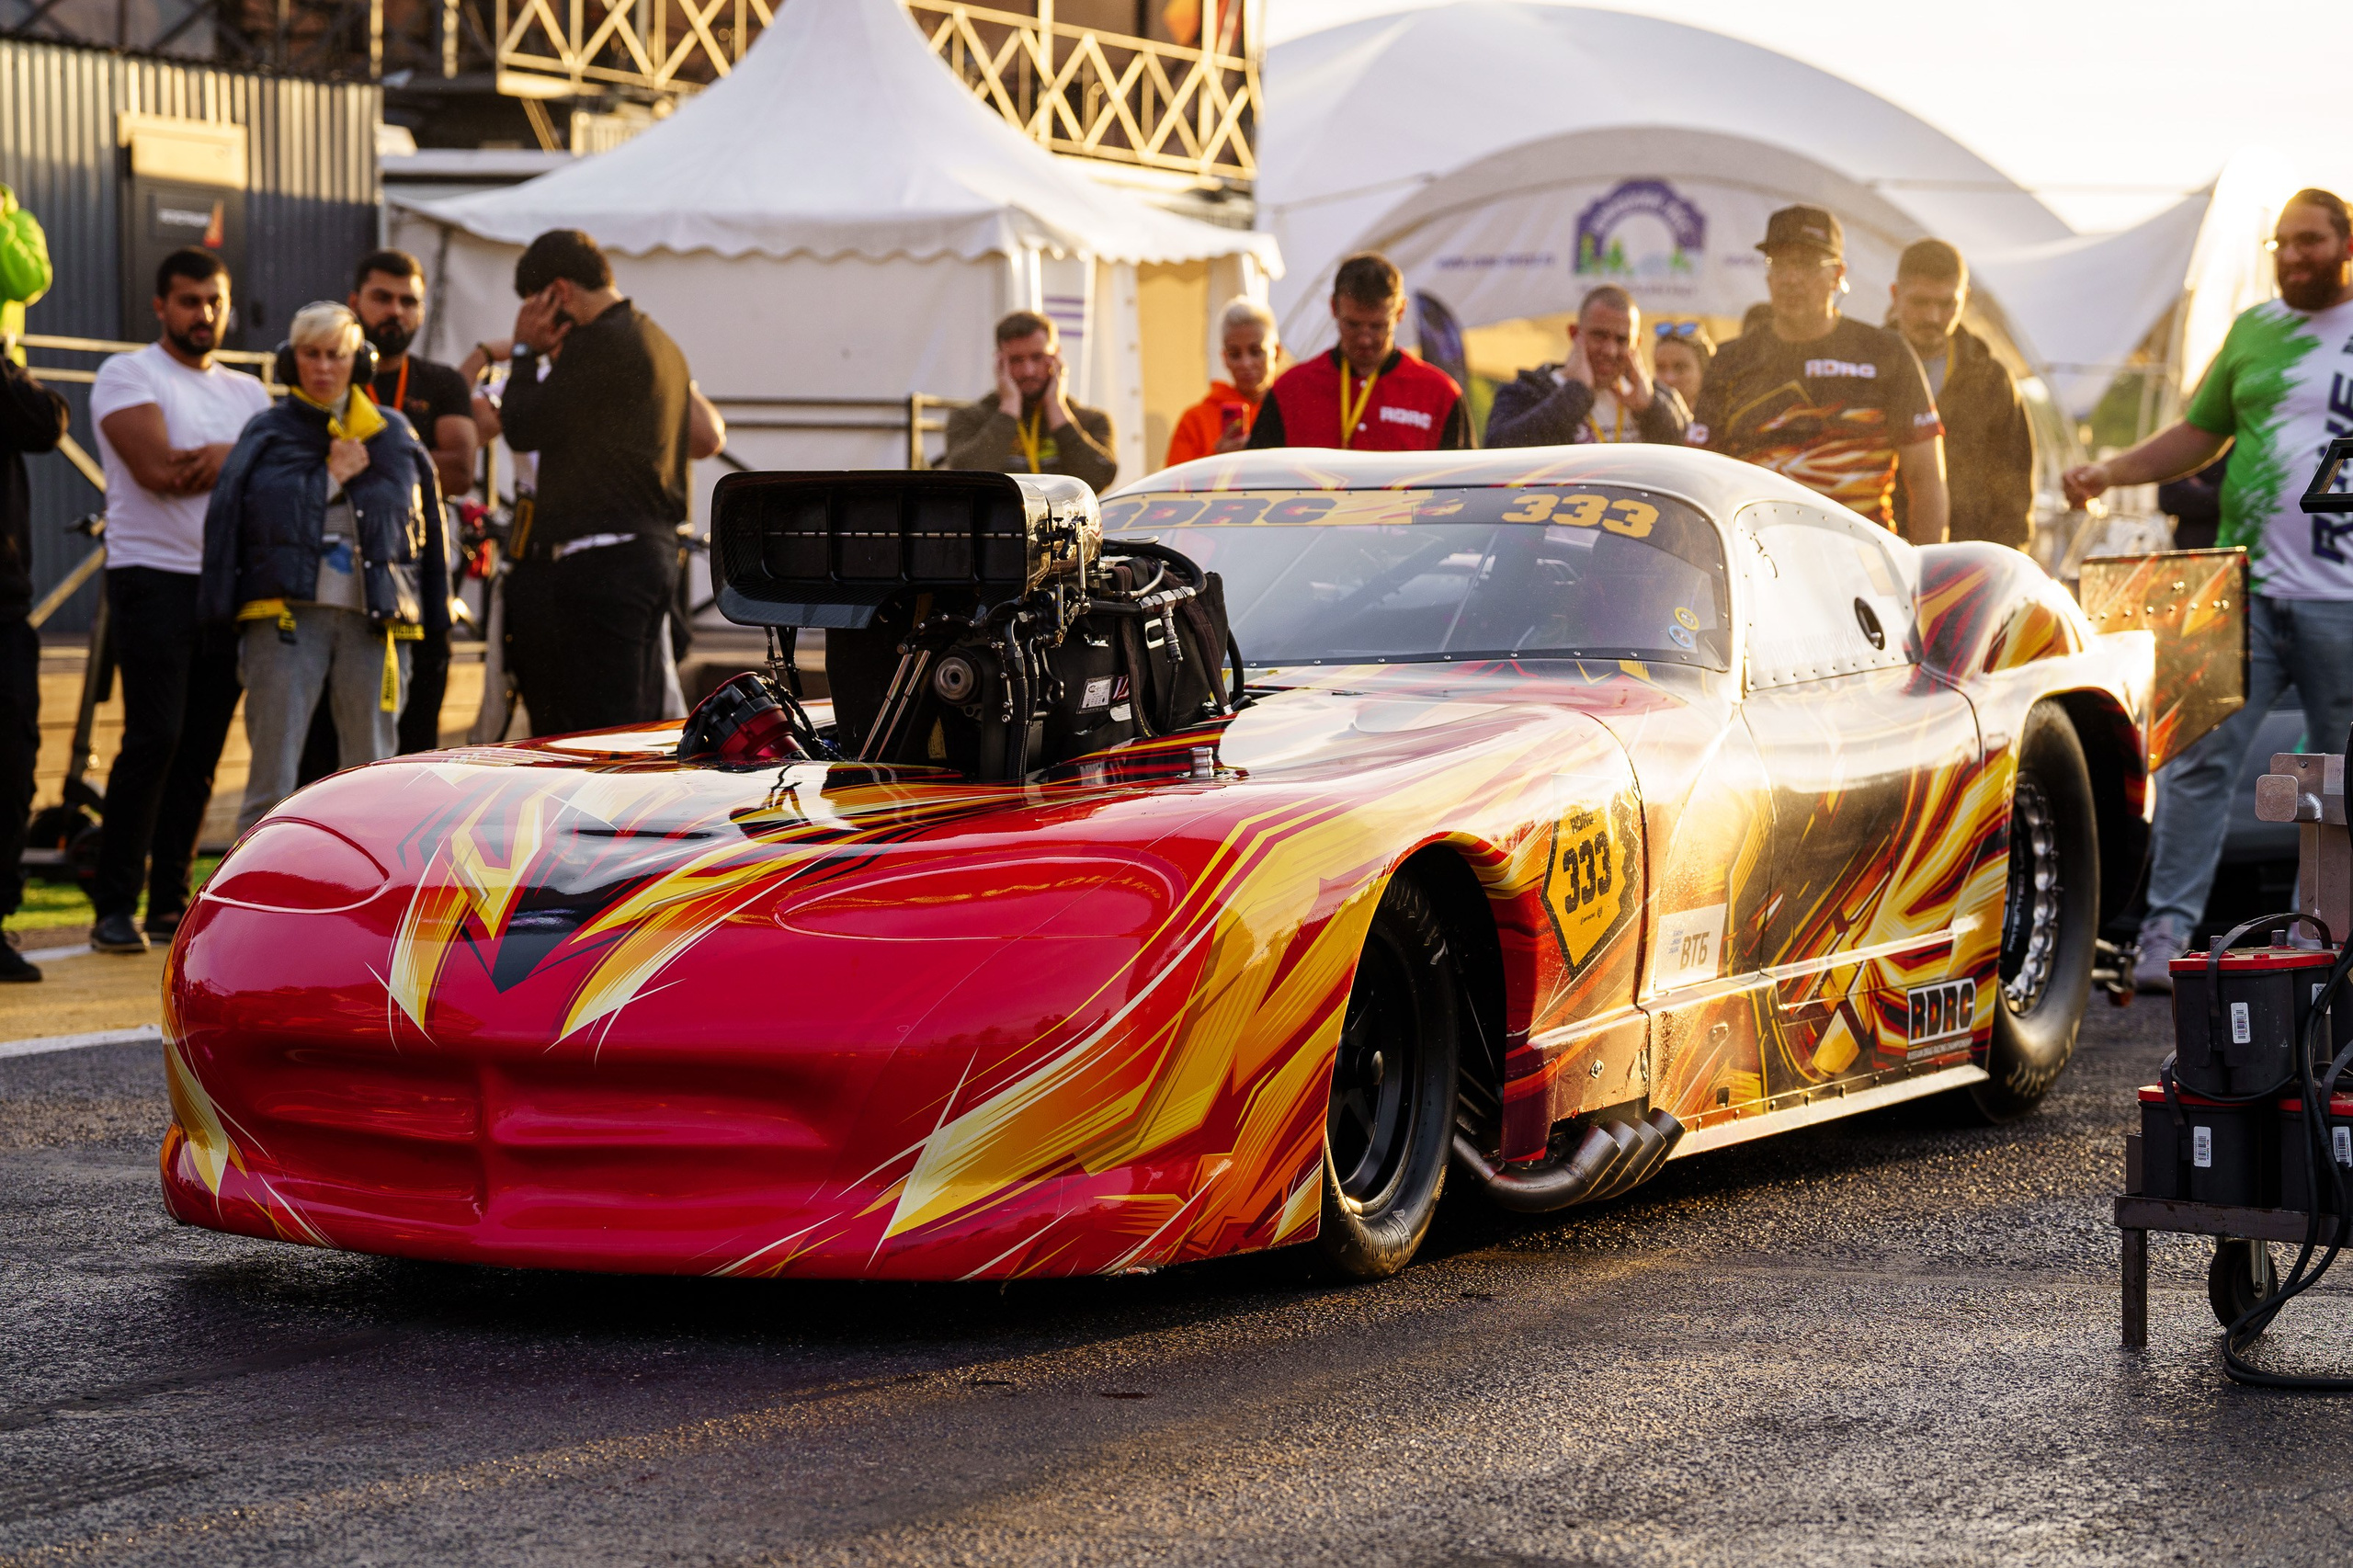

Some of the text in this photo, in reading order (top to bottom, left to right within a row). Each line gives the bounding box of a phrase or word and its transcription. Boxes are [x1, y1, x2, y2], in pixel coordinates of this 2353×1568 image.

[1501, 494, 1660, 538] 333
[1563, 830, 1611, 915] 333
[1908, 979, 1976, 1045] RDRC
